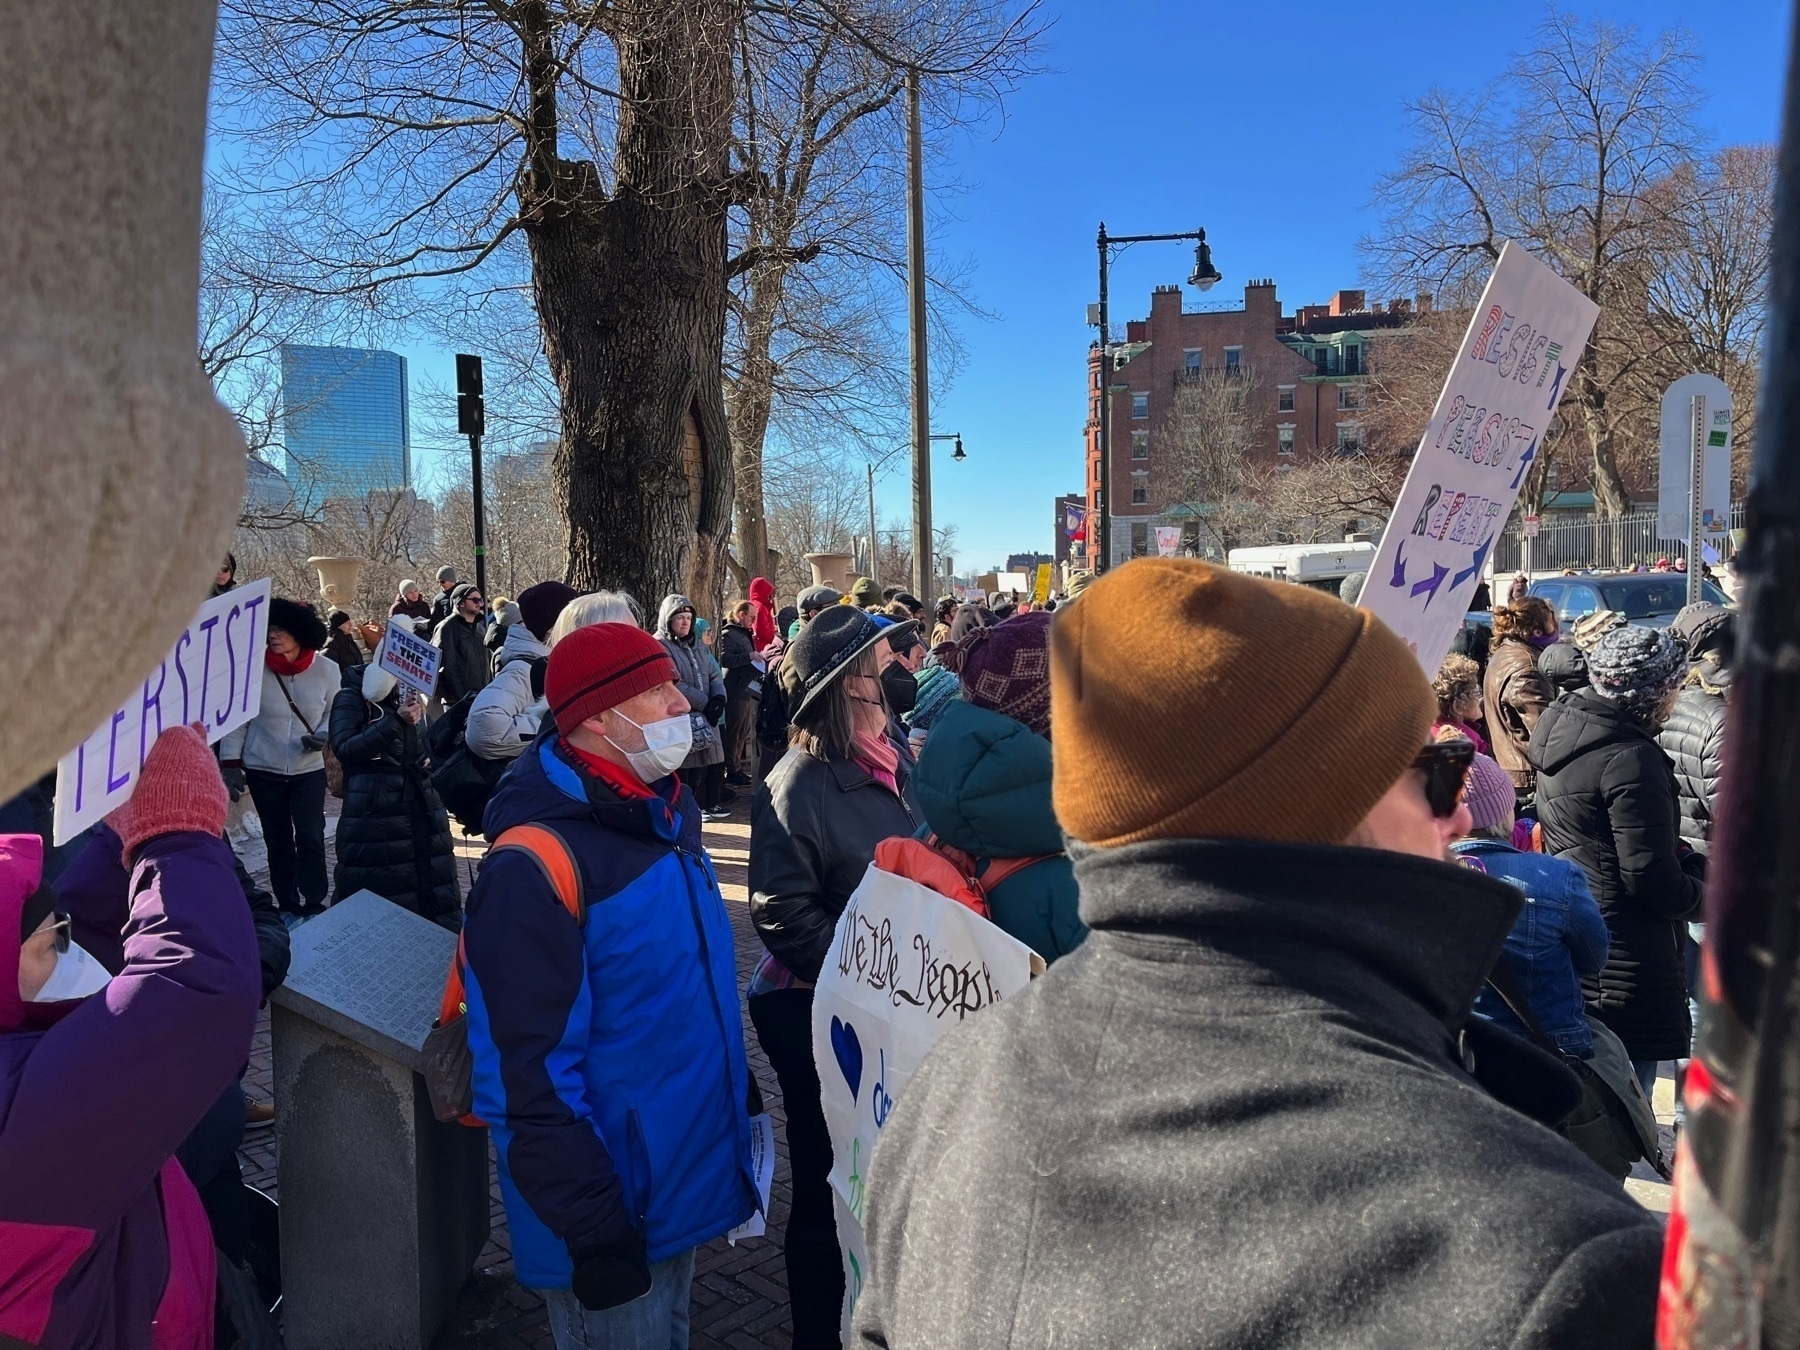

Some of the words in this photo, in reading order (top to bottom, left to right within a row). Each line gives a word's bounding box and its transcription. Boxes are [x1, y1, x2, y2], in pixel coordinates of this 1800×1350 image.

[1471, 305, 1563, 388] RESIST
[1436, 395, 1534, 471] PERSIST
[1411, 484, 1502, 546] REPEAT
[386, 650, 432, 685] SENATE
[390, 629, 436, 663] FREEZE
[400, 646, 423, 668] THE
[312, 938, 334, 954] THE
[838, 898, 868, 982] We
